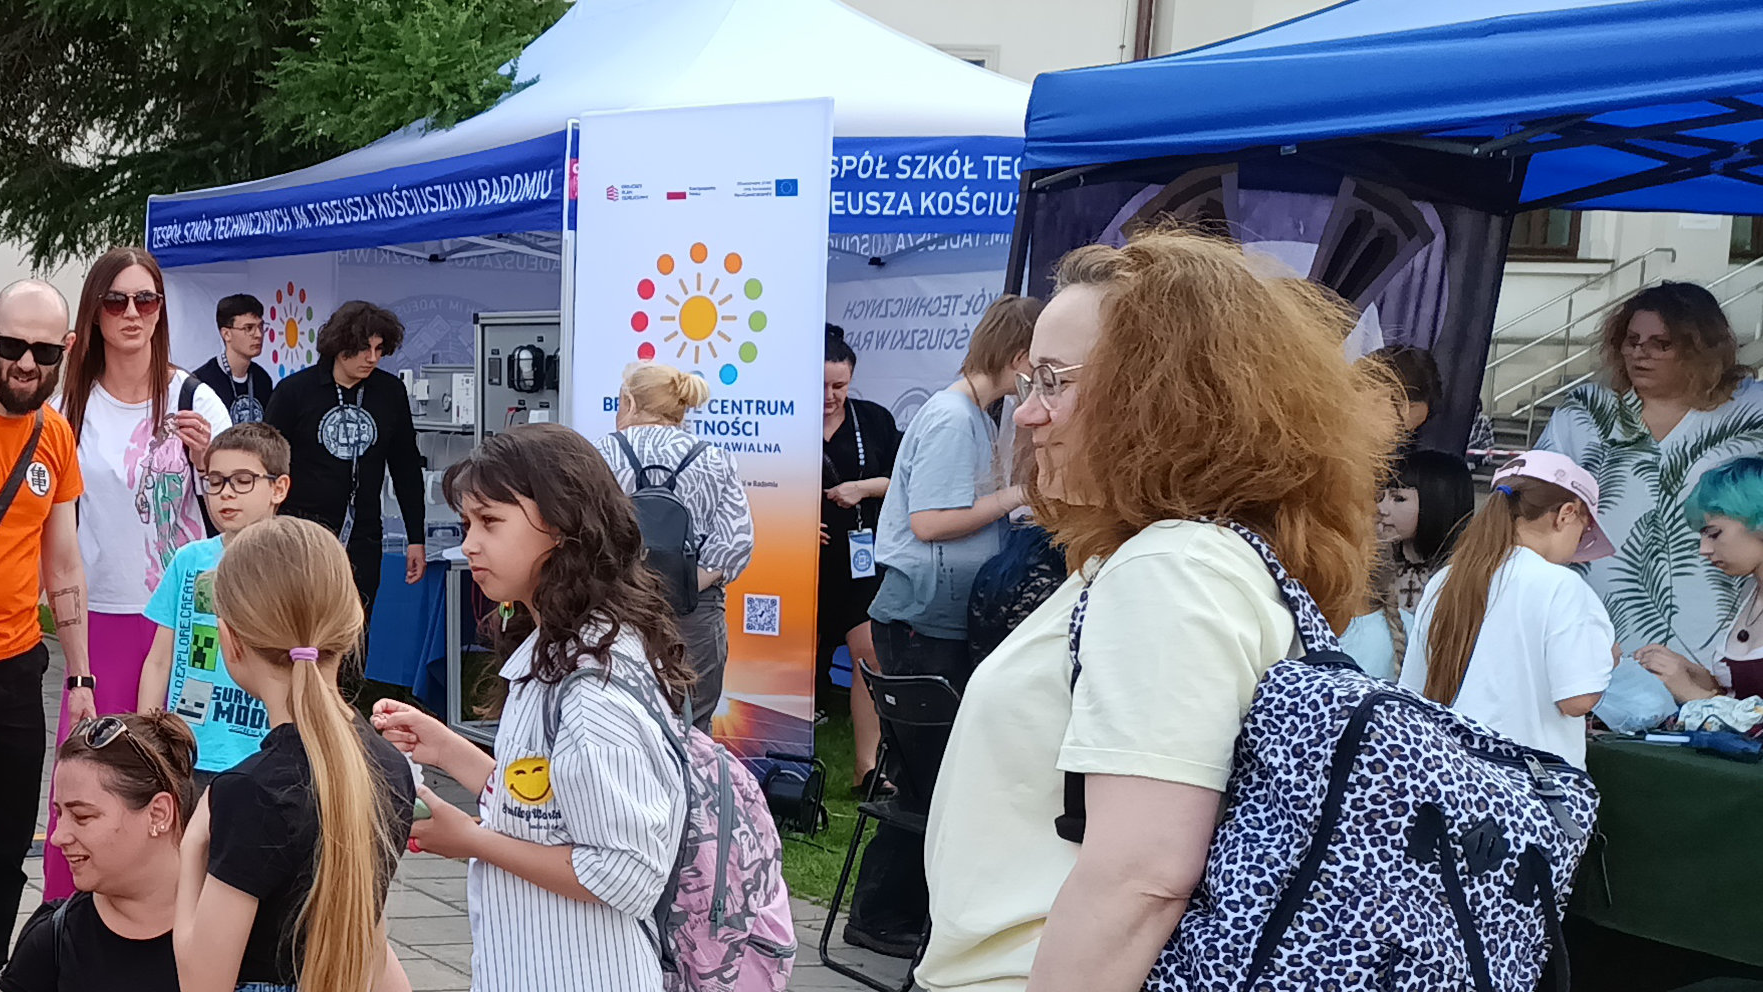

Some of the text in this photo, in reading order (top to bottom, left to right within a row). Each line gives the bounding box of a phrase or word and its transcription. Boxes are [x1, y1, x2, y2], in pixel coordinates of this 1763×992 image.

[829, 150, 890, 180] SPÓŁ
[895, 149, 978, 180] SZKÓŁ
[213, 206, 293, 240] TECHNICZNYCH
[307, 196, 377, 227] TADEUSZA
[372, 183, 462, 219] KOŚCIUSZKI
[459, 180, 477, 208] W
[477, 168, 555, 207] RADOMIU
[831, 185, 1018, 216] EUSZA KOŚCIU
[707, 398, 795, 416] CENTRUM
[713, 441, 782, 454] NAWIALNA
[212, 701, 271, 730] MOD
